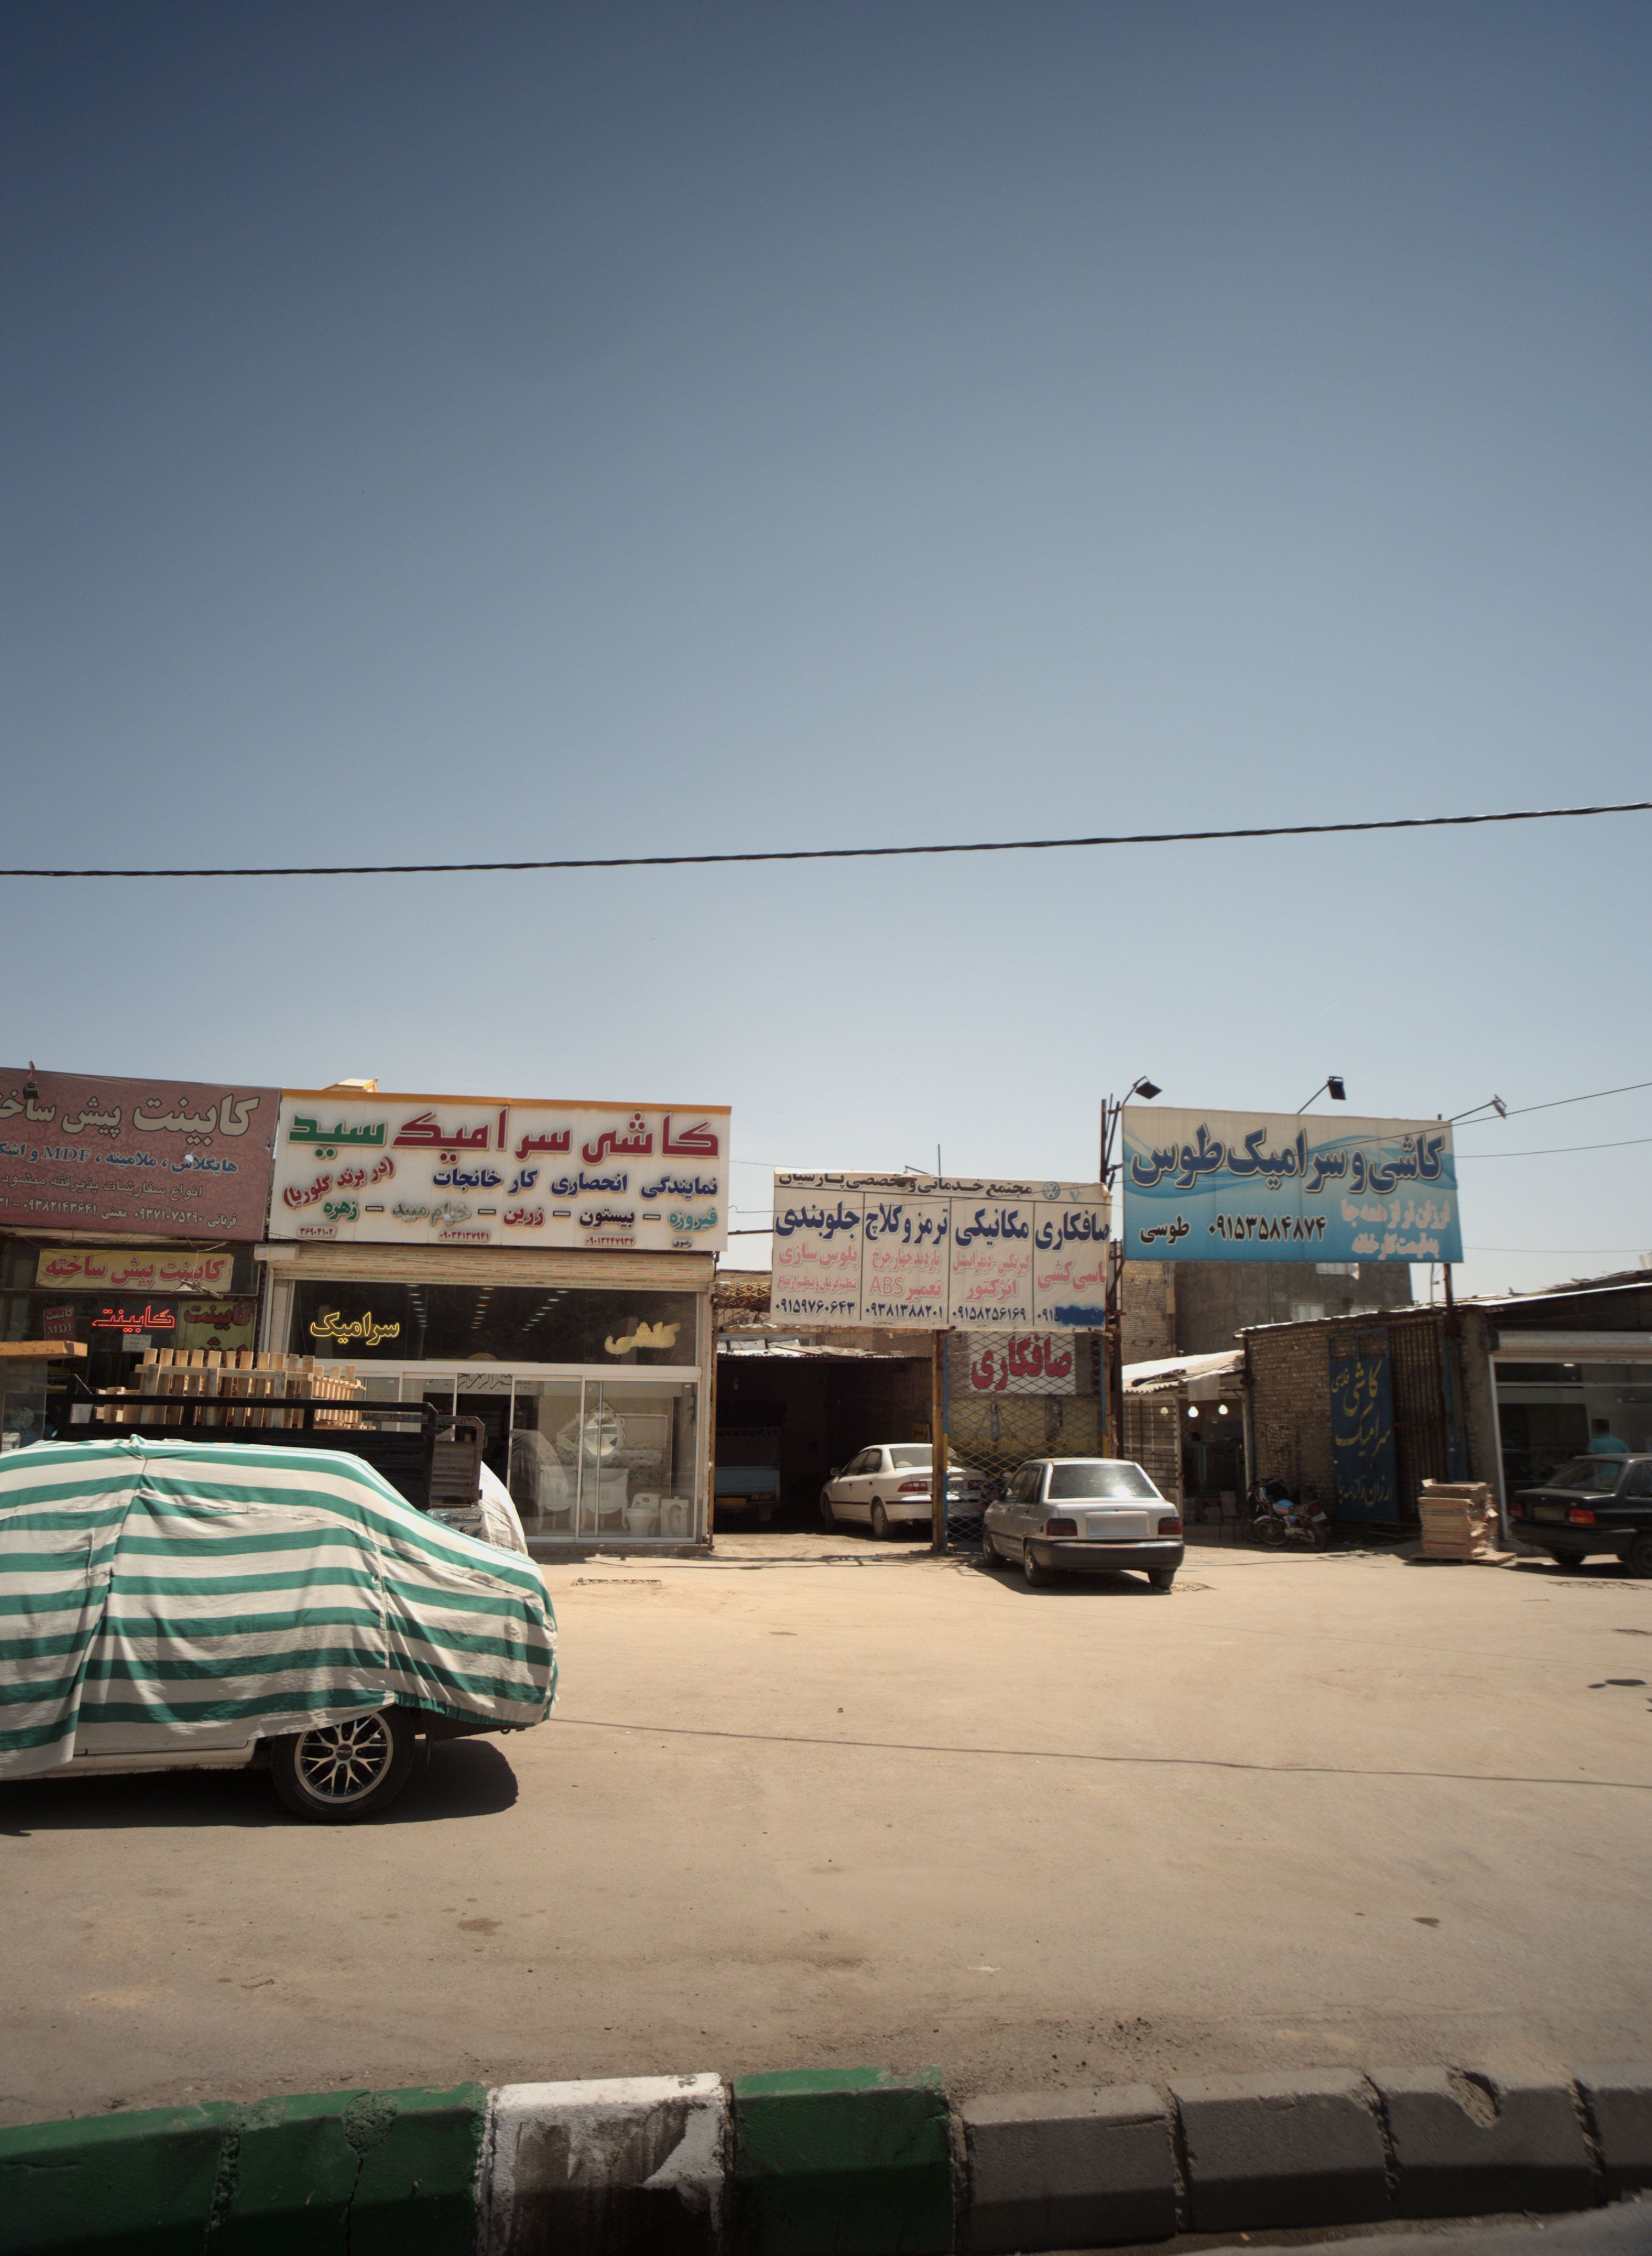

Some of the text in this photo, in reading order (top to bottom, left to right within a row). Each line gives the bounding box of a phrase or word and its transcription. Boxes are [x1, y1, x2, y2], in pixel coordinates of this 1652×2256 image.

[0, 1089, 260, 1146] کابینت پیش ساخ
[289, 1105, 719, 1164] کاشی سرامیک سید
[28, 1149, 39, 1163] و
[43, 1146, 90, 1161] MDF
[1131, 1123, 1444, 1193] کاشی و سرامیک طوس
[51, 1175, 99, 1194] پذیرفته
[103, 1180, 166, 1197] سفارشات
[336, 1168, 366, 1189] برند
[551, 1172, 628, 1196] انحصاری
[640, 1175, 718, 1199] نمایندگی
[986, 1182, 1032, 1197] مجتمع
[170, 1184, 203, 1201] انواع
[208, 1213, 237, 1229] قربانی
[323, 1201, 358, 1220] زهره
[504, 1206, 545, 1225] زرین
[579, 1209, 635, 1228] بیستون
[669, 1207, 718, 1231] فیروزه
[775, 1201, 861, 1239] جلوبندی
[865, 1202, 948, 1245] ترمز و کلاچ
[955, 1208, 1030, 1246] مکانیکی
[1139, 1214, 1327, 1244] طوسی ۰۹۱۵۳۵۸۴۸۷۴
[779, 1243, 857, 1267] پلوس سازی
[45, 1255, 227, 1288] کابینت پیش ساخته
[1037, 1260, 1073, 1289] کشی
[870, 1276, 942, 1300] تعمیر ABS
[965, 1278, 1017, 1301] انژکتور
[92, 1305, 175, 1333] کابینت
[184, 1301, 255, 1331] کابینت
[775, 1298, 855, 1316] ۰۹۱۵۹۷۶۰۶۴۳
[47, 1322, 75, 1335] MDF
[310, 1311, 400, 1345] سرامیک
[605, 1321, 681, 1354] کاشی
[972, 1334, 1072, 1390] صافکاری
[1343, 1359, 1383, 1417] کاشی
